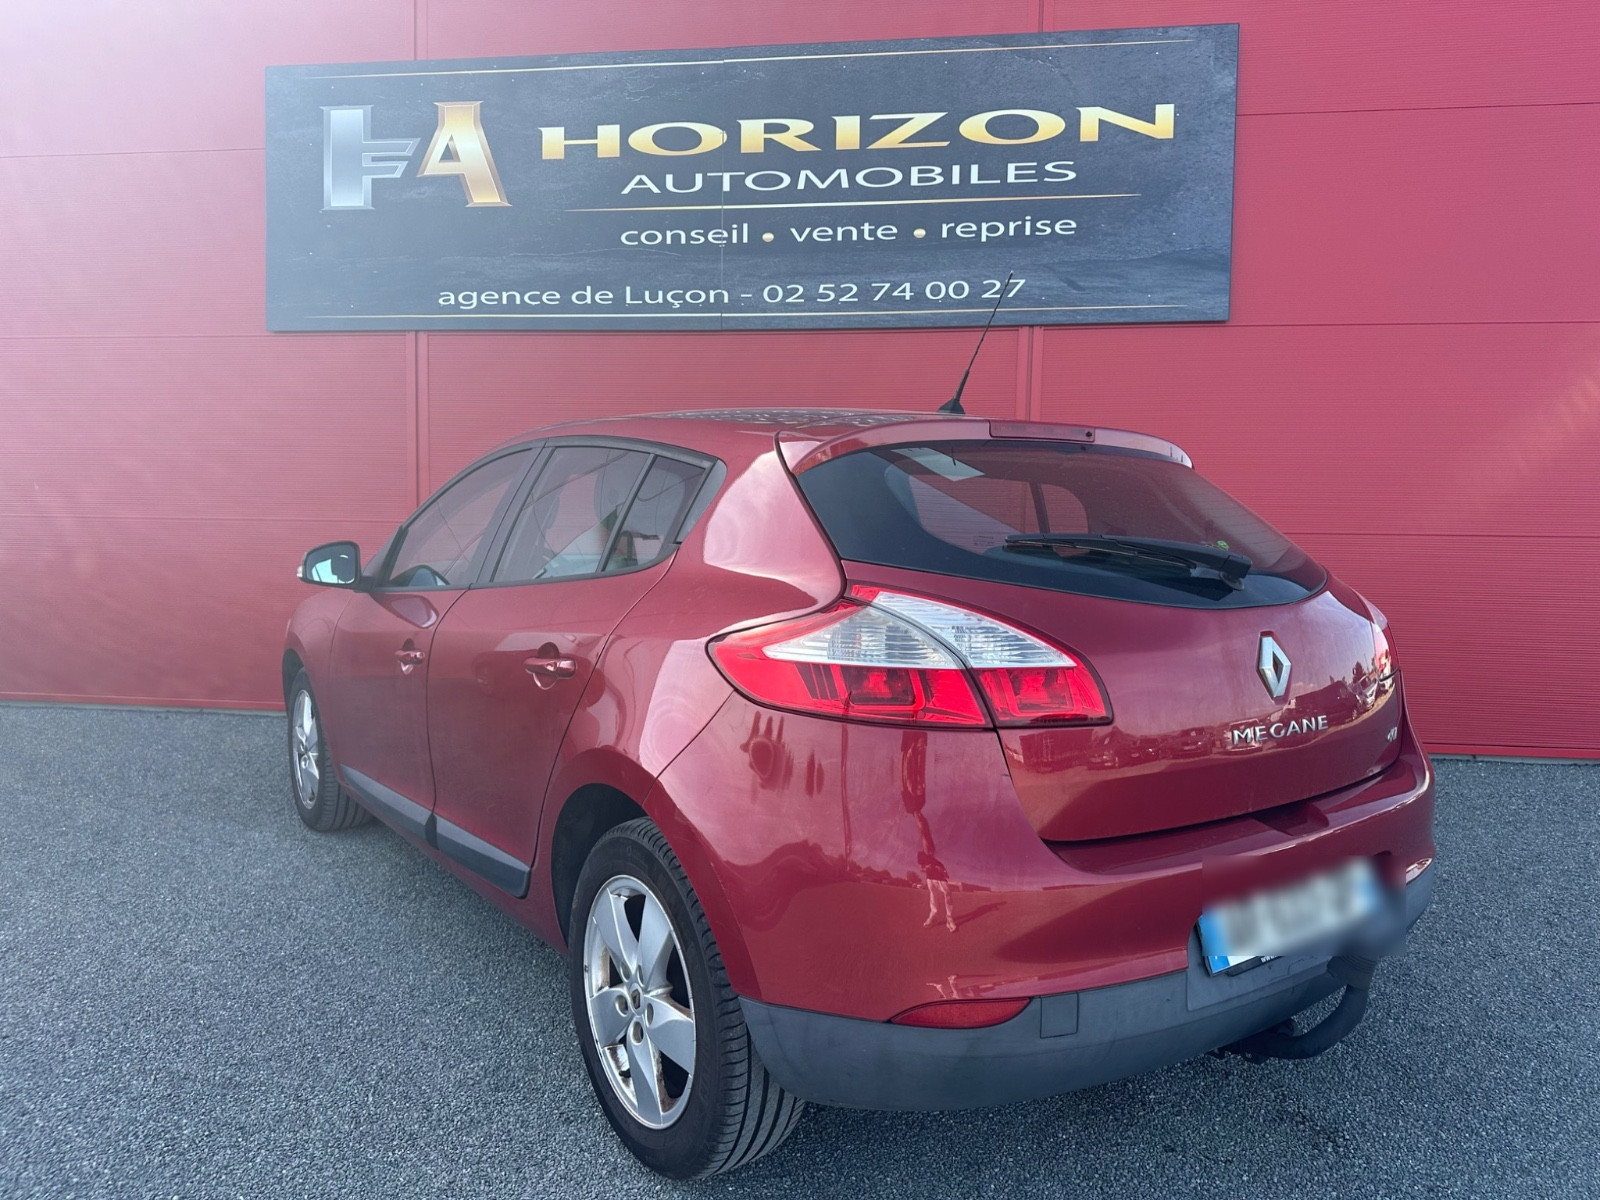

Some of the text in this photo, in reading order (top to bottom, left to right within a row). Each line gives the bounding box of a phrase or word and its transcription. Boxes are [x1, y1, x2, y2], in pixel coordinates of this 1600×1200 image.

[538, 103, 1176, 160] HORIZON
[621, 160, 1078, 195] AUTOMOBILES
[620, 214, 1078, 246] conseil vente reprise
[437, 289, 562, 310] agence
[571, 286, 615, 306] de
[624, 286, 731, 309] Luçon
[762, 283, 806, 304] 02
[816, 283, 860, 303] 52
[871, 282, 914, 301] 74
[925, 280, 970, 300] 00
[981, 279, 1026, 299] 27
[1232, 715, 1329, 745] MEGANE
